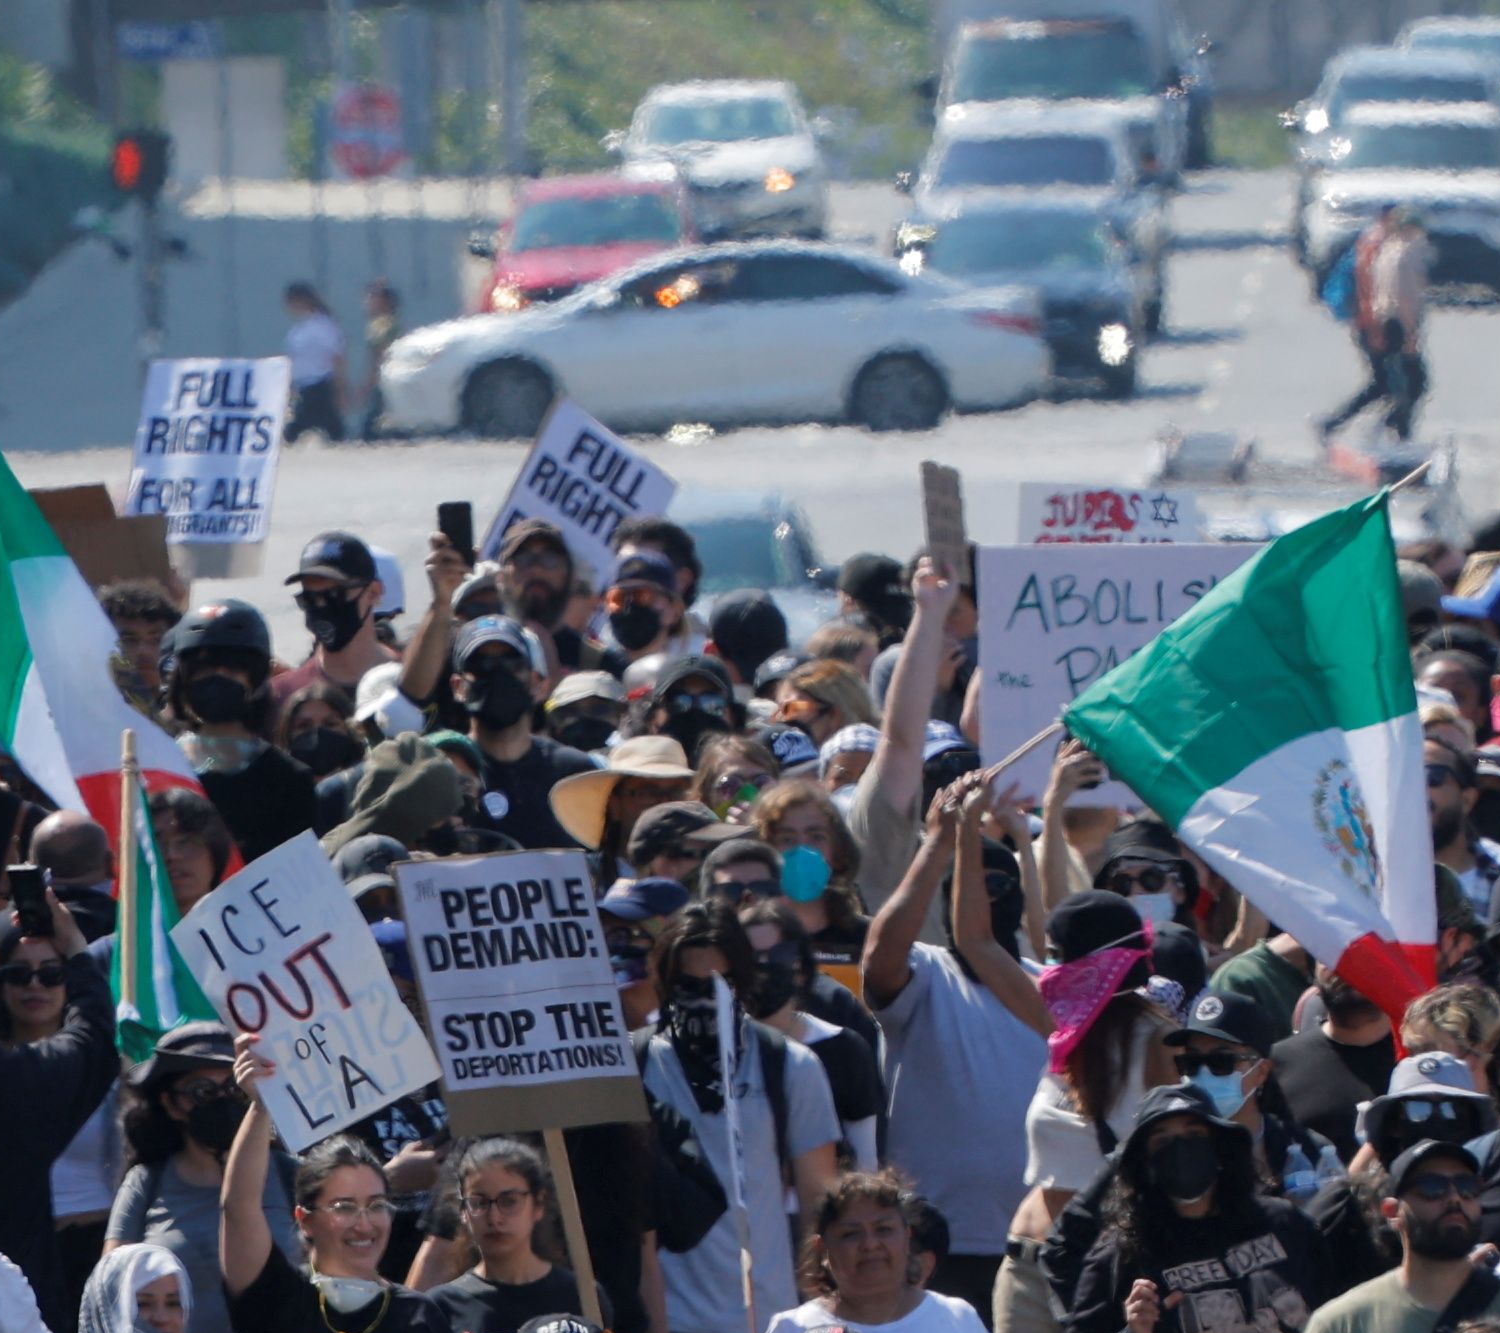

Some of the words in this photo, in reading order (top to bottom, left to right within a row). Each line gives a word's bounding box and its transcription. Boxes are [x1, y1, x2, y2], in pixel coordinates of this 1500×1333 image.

[176, 370, 257, 409] FULL
[144, 416, 274, 456] RIGHTS
[138, 477, 194, 513] FOR
[205, 477, 262, 512] ALL
[566, 430, 647, 511] FULL
[526, 456, 622, 546] RIGHT
[203, 879, 300, 971] ICE
[442, 877, 590, 929] PEOPLE
[423, 920, 600, 973] DEMAND:
[227, 932, 354, 1033] OUT
[446, 1008, 537, 1052] STOP
[545, 1002, 619, 1040] THE
[454, 1050, 626, 1080] DEPORTATIONS!
